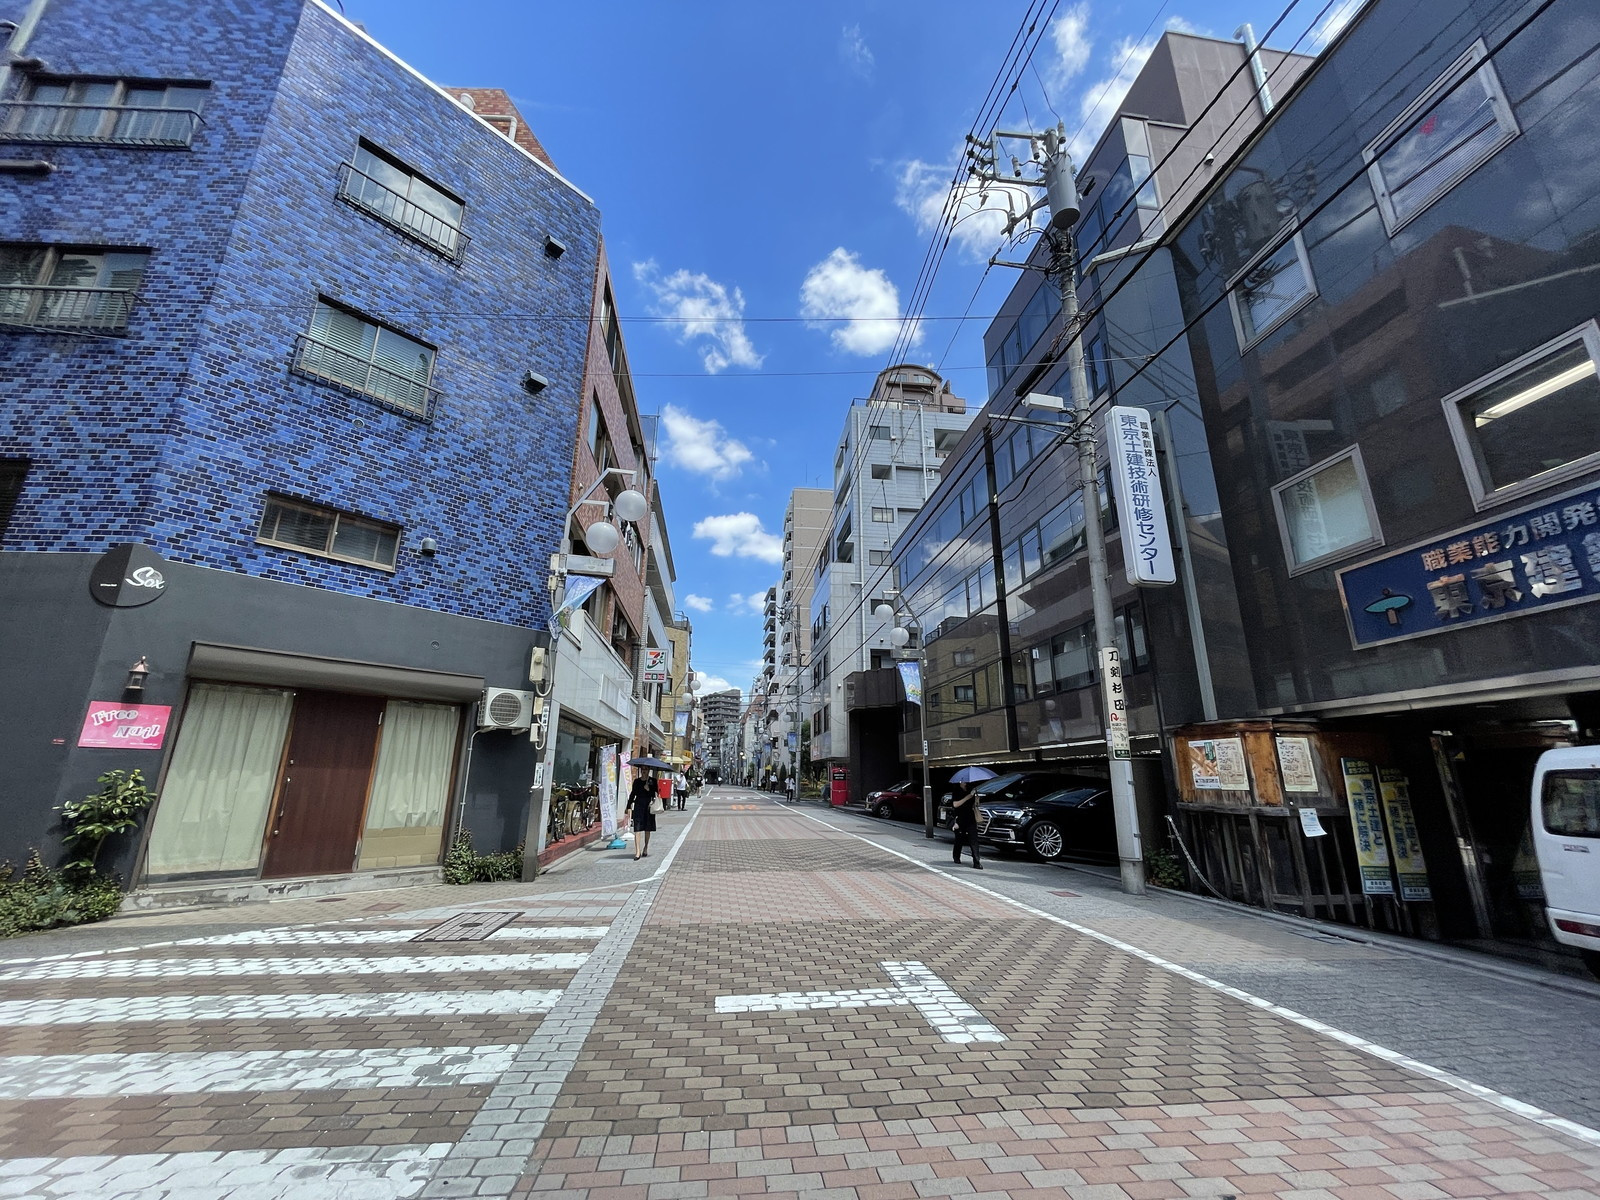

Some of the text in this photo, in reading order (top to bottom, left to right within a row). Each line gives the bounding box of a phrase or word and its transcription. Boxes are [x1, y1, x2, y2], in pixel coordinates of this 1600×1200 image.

[1139, 421, 1157, 477] 職業訓練法人
[1119, 414, 1158, 575] 東京土建技術研修センター
[1420, 495, 1600, 571] 職業能力開発
[125, 566, 165, 589] Sox
[1108, 650, 1125, 711] 刀剣杉田
[91, 709, 139, 727] Free
[112, 724, 161, 740] Nail
